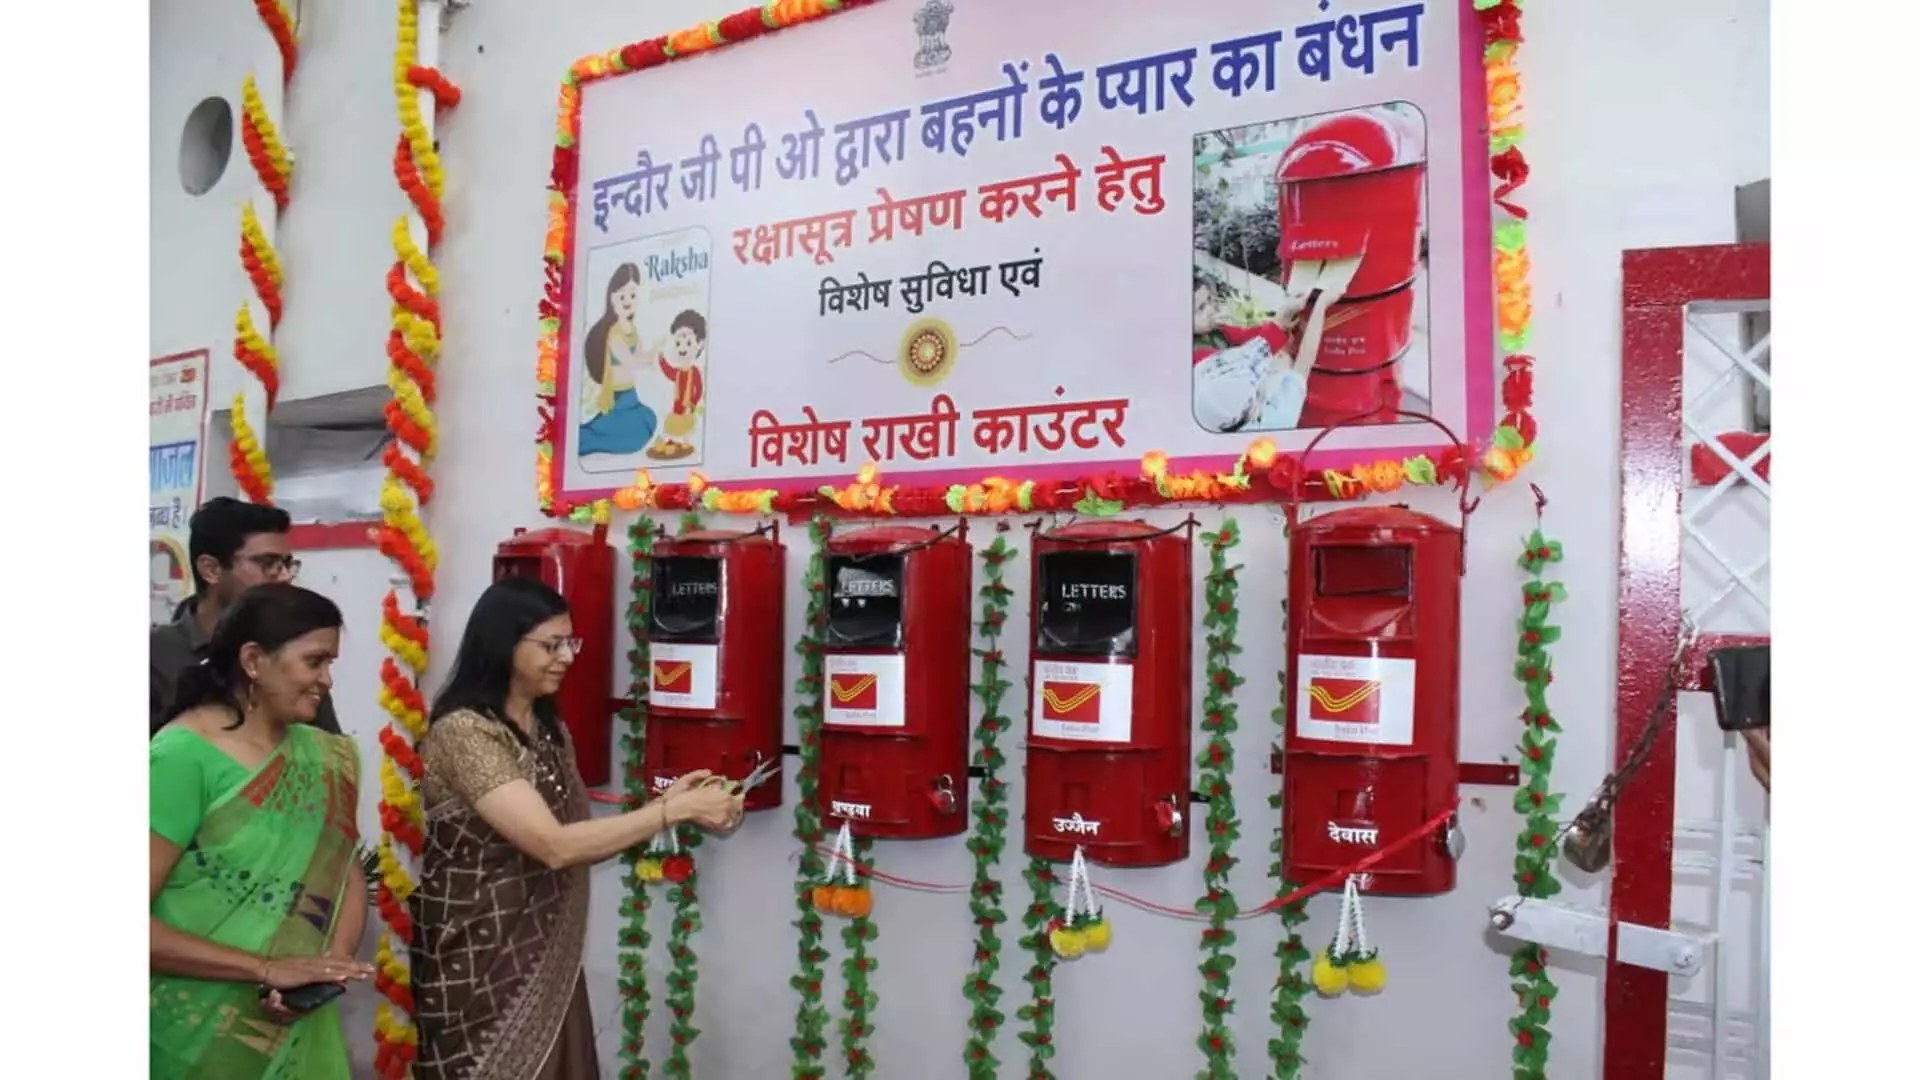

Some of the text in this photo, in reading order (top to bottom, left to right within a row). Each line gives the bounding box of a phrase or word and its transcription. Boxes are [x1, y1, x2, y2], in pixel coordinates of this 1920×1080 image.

[593, 0, 1424, 232] इन्दौर जी पी ओ द्वारा बहनों के प्यार का बंधन
[732, 146, 1166, 266] रक्षासूत्र प्रेषण करने हेतु
[643, 247, 708, 282] Raksha
[819, 247, 1043, 316] विशेष सुविधा एवं
[748, 385, 1129, 468] विशेष राखी काउंटर
[1062, 584, 1127, 599] LETTERS
[1053, 812, 1100, 836] उज्जैन
[1328, 821, 1378, 845] देवास
